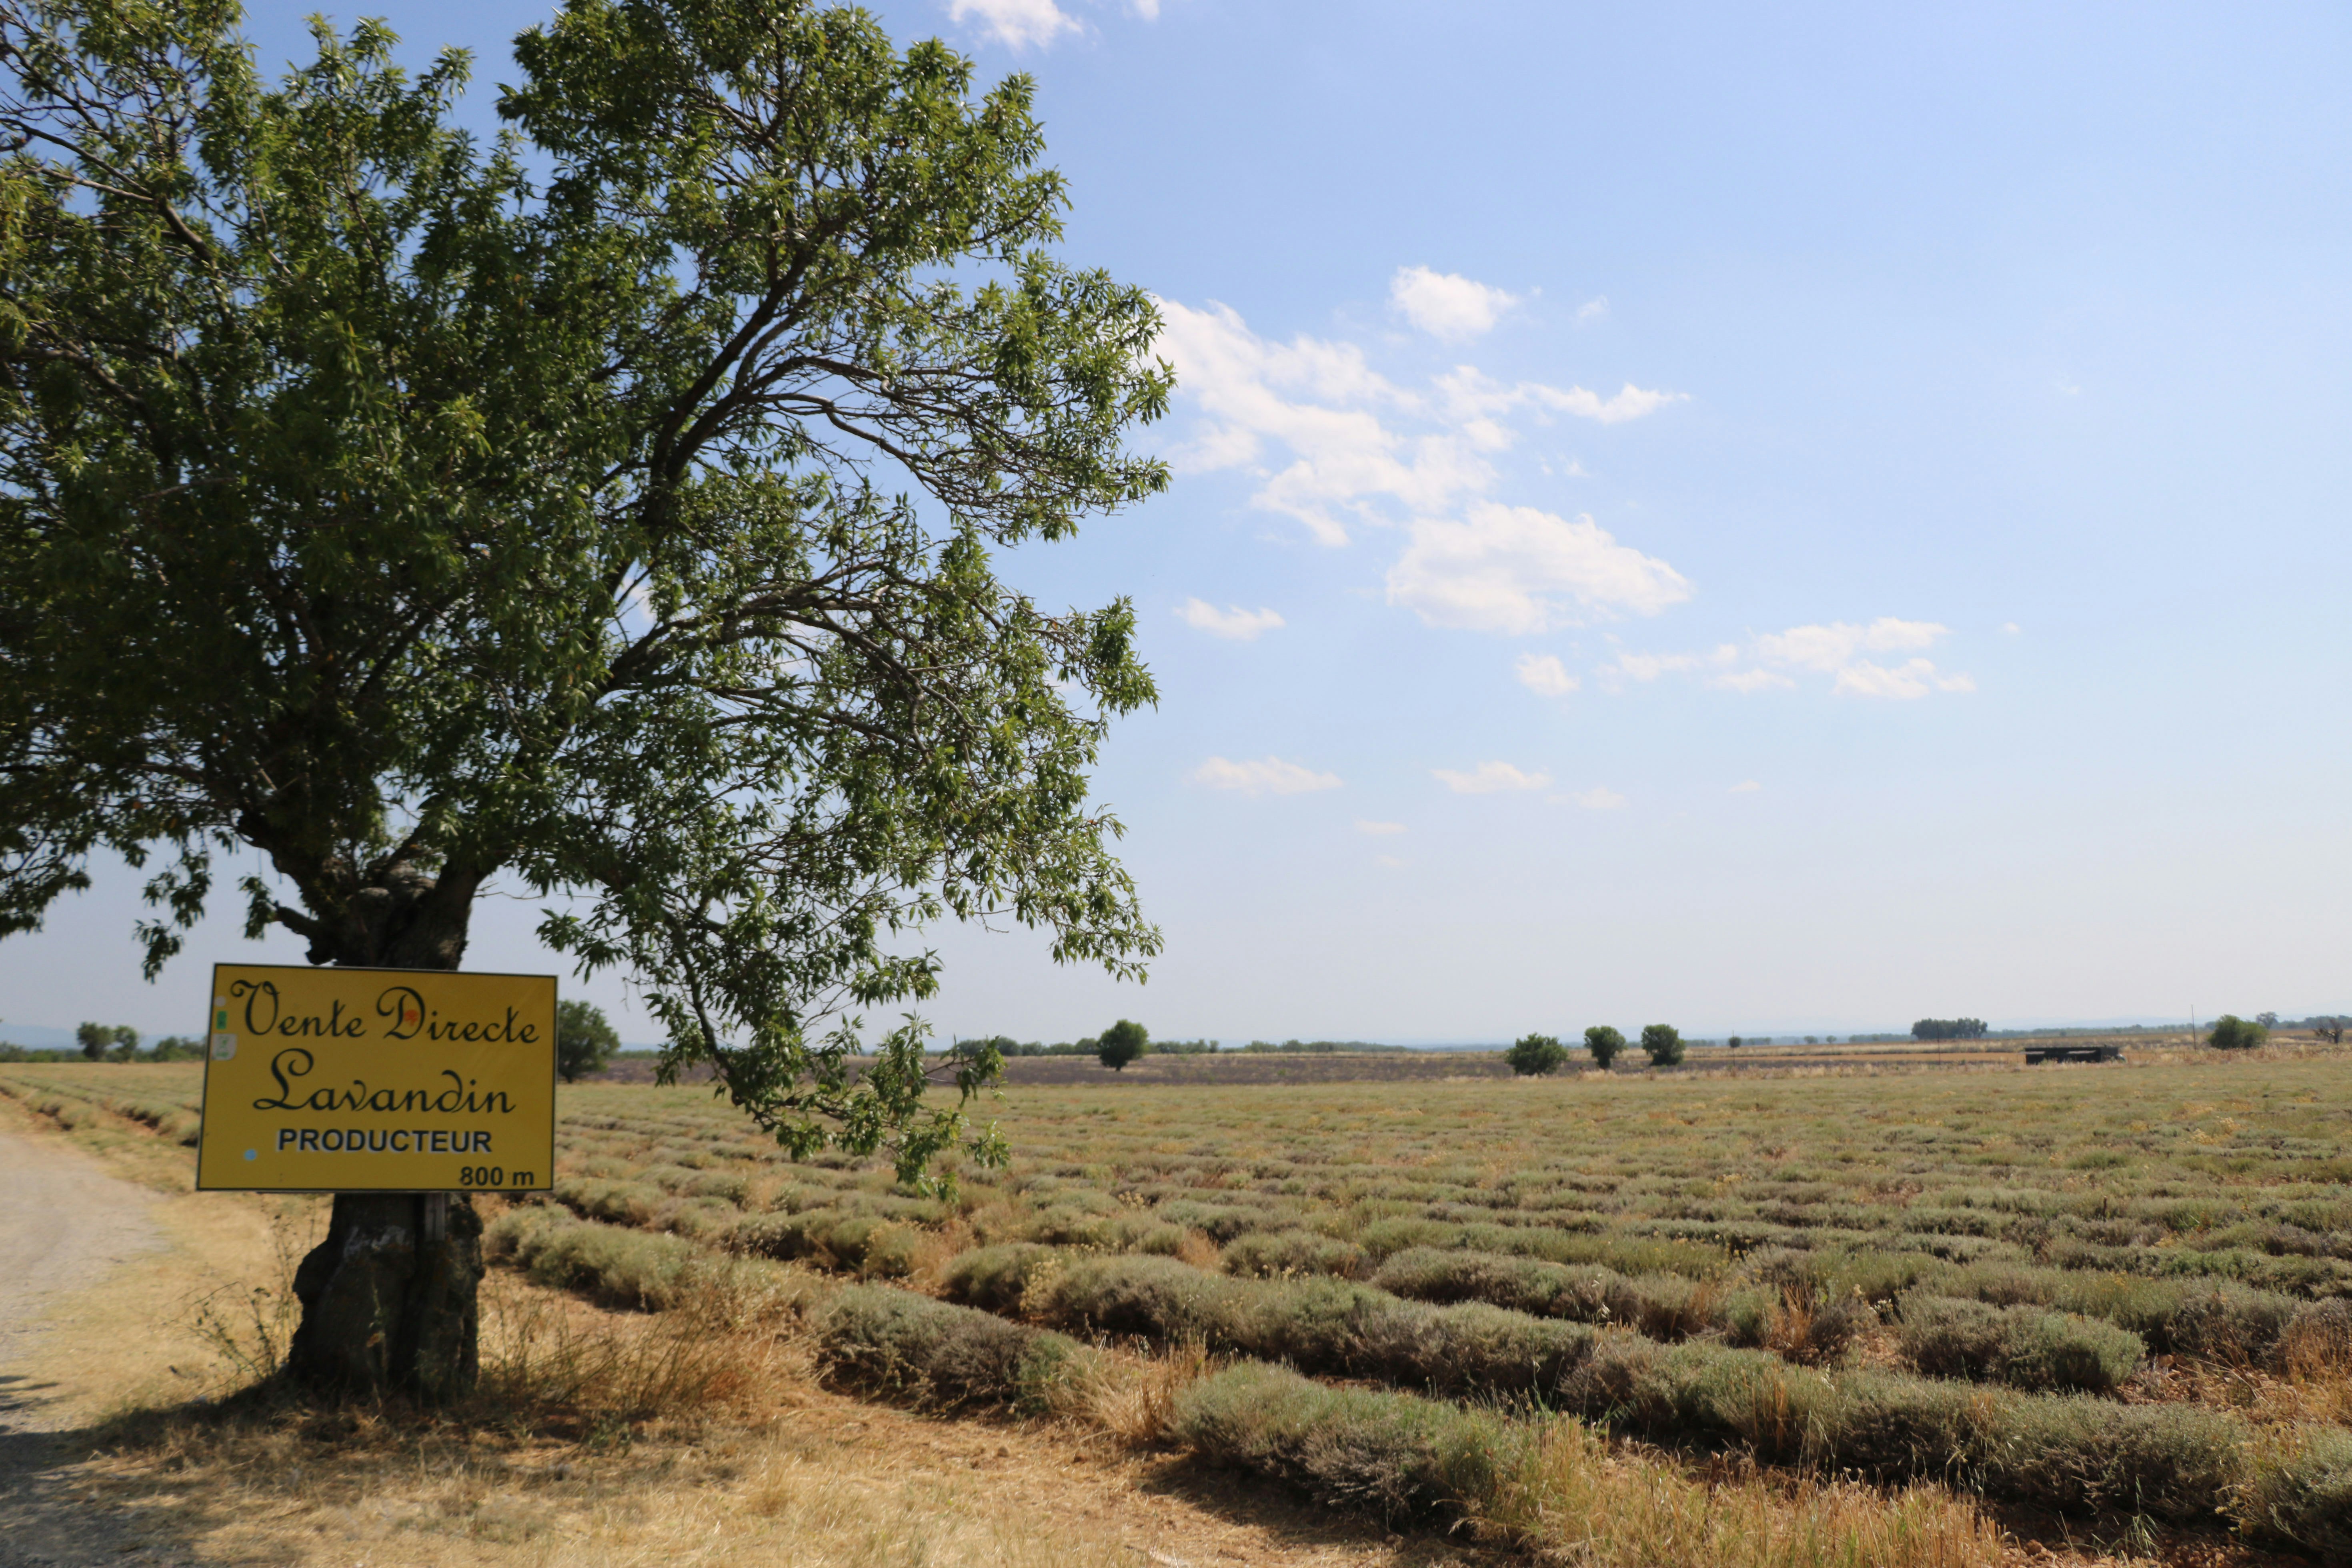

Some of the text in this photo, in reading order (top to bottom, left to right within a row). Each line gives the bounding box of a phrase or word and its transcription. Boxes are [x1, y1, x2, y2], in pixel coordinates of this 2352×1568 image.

[230, 979, 540, 1043] Vente Directe
[253, 1048, 516, 1113] Lavandin
[278, 1129, 492, 1152] PRODUCTEUR
[460, 1166, 534, 1186] 800 m
